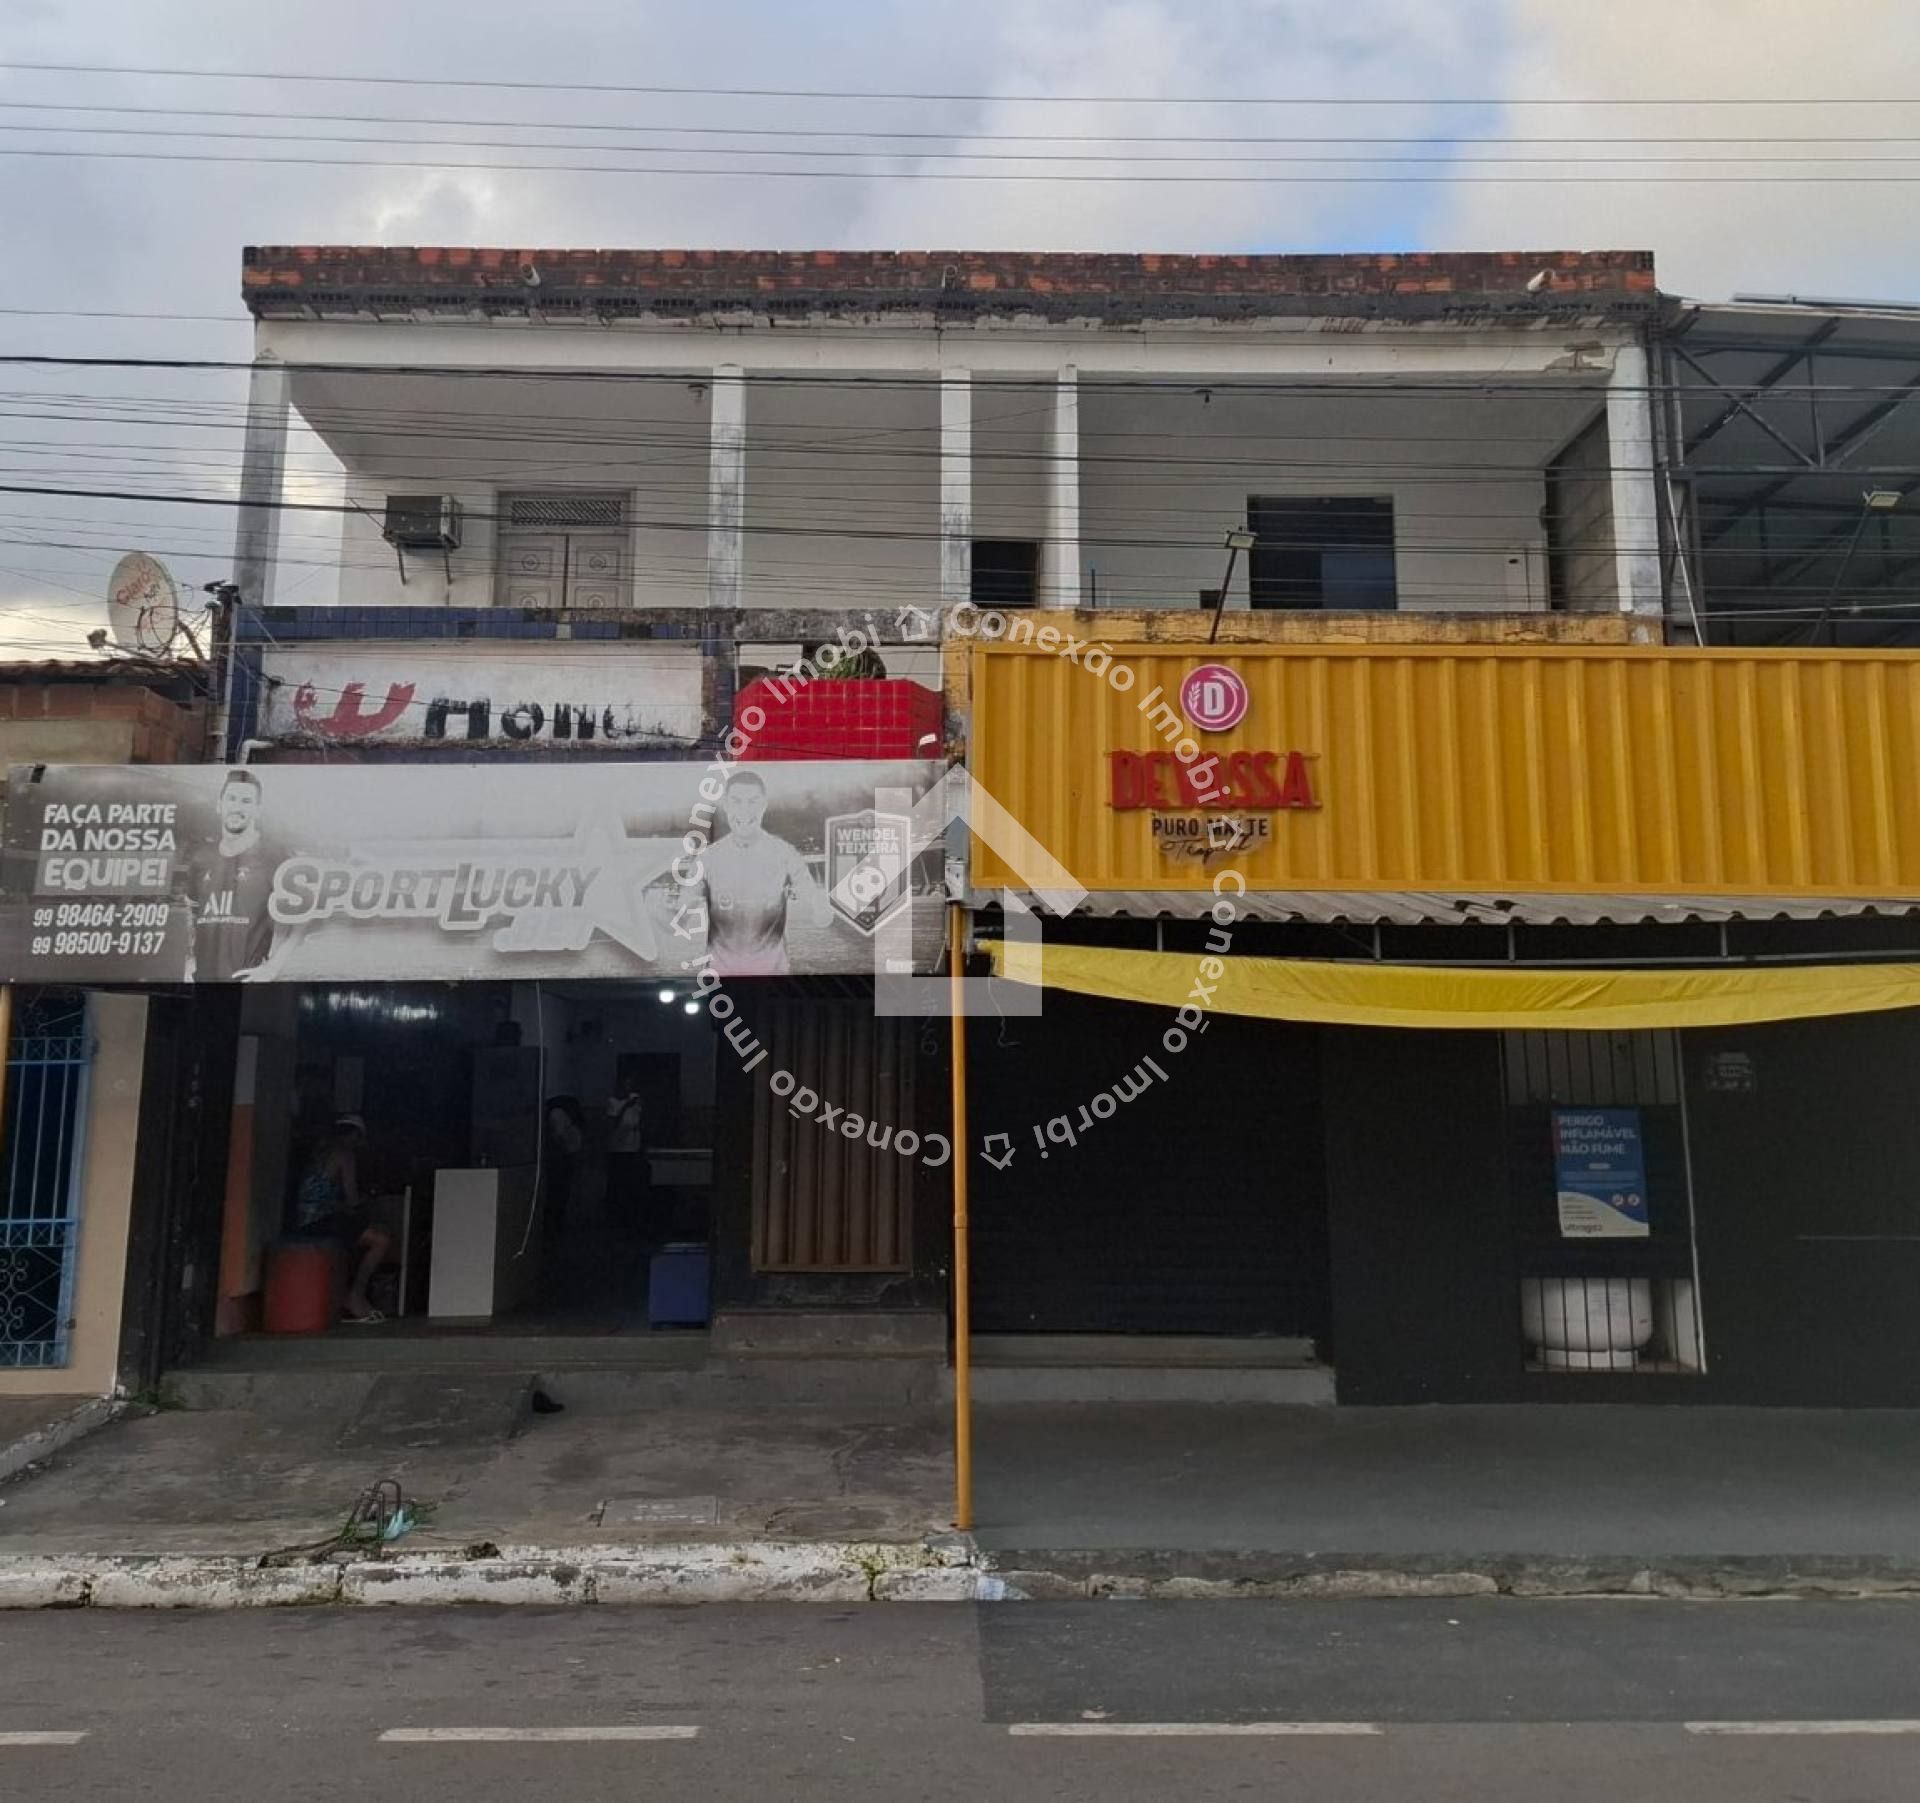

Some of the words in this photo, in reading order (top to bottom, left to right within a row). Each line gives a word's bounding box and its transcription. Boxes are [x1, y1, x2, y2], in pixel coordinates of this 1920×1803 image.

[1204, 682, 1225, 715] D
[44, 804, 102, 828] FAÇA
[107, 804, 177, 824] PARTE
[837, 828, 899, 841] WENDEL
[1152, 817, 1199, 836] PURO
[41, 829, 81, 850] DA
[84, 829, 176, 851] NOSSA
[837, 841, 898, 854] TEIXEIRA
[44, 858, 167, 890] EQUIPE!
[33, 909, 54, 927] 99
[56, 904, 169, 927] 98464-2909
[32, 937, 52, 955] 99
[54, 932, 165, 955] 98500-9137
[1557, 1114, 1604, 1126] PERIGO
[1559, 1125, 1637, 1139] INFLAMÁVEL
[1560, 1140, 1589, 1154] NÃO
[1591, 1142, 1625, 1154] FUME
